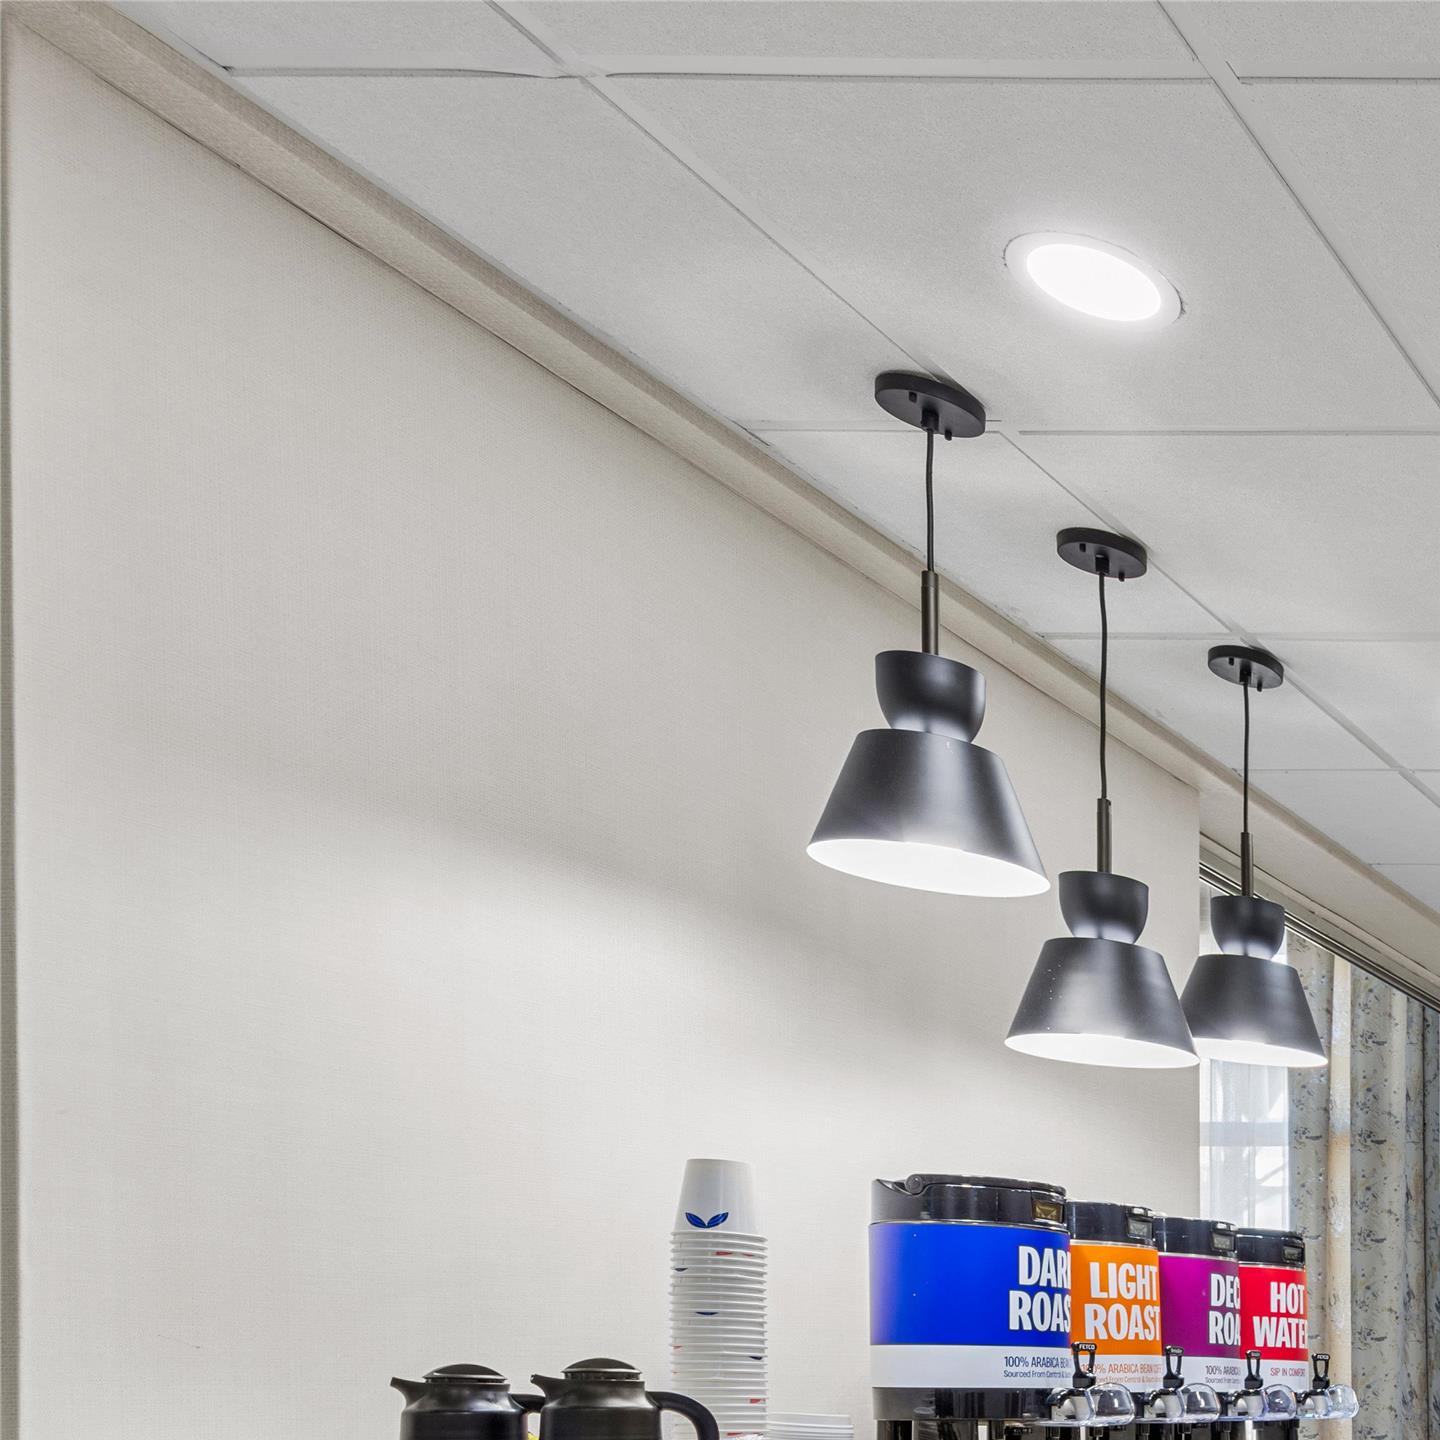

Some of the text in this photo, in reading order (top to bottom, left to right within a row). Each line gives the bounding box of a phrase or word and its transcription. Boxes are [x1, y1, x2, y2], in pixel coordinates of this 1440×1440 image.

[1089, 1262, 1158, 1301] LIGHT
[1270, 1281, 1305, 1315] HOT
[1084, 1303, 1160, 1341] ROAST
[1004, 1356, 1029, 1368] 100%
[1031, 1356, 1060, 1369] ARABICA
[1108, 1363, 1139, 1374] ARABICA
[1003, 1370, 1031, 1378] Sourced
[1205, 1366, 1222, 1376] 100%
[1270, 1368, 1280, 1377] SIP
[1281, 1368, 1288, 1376] IN
